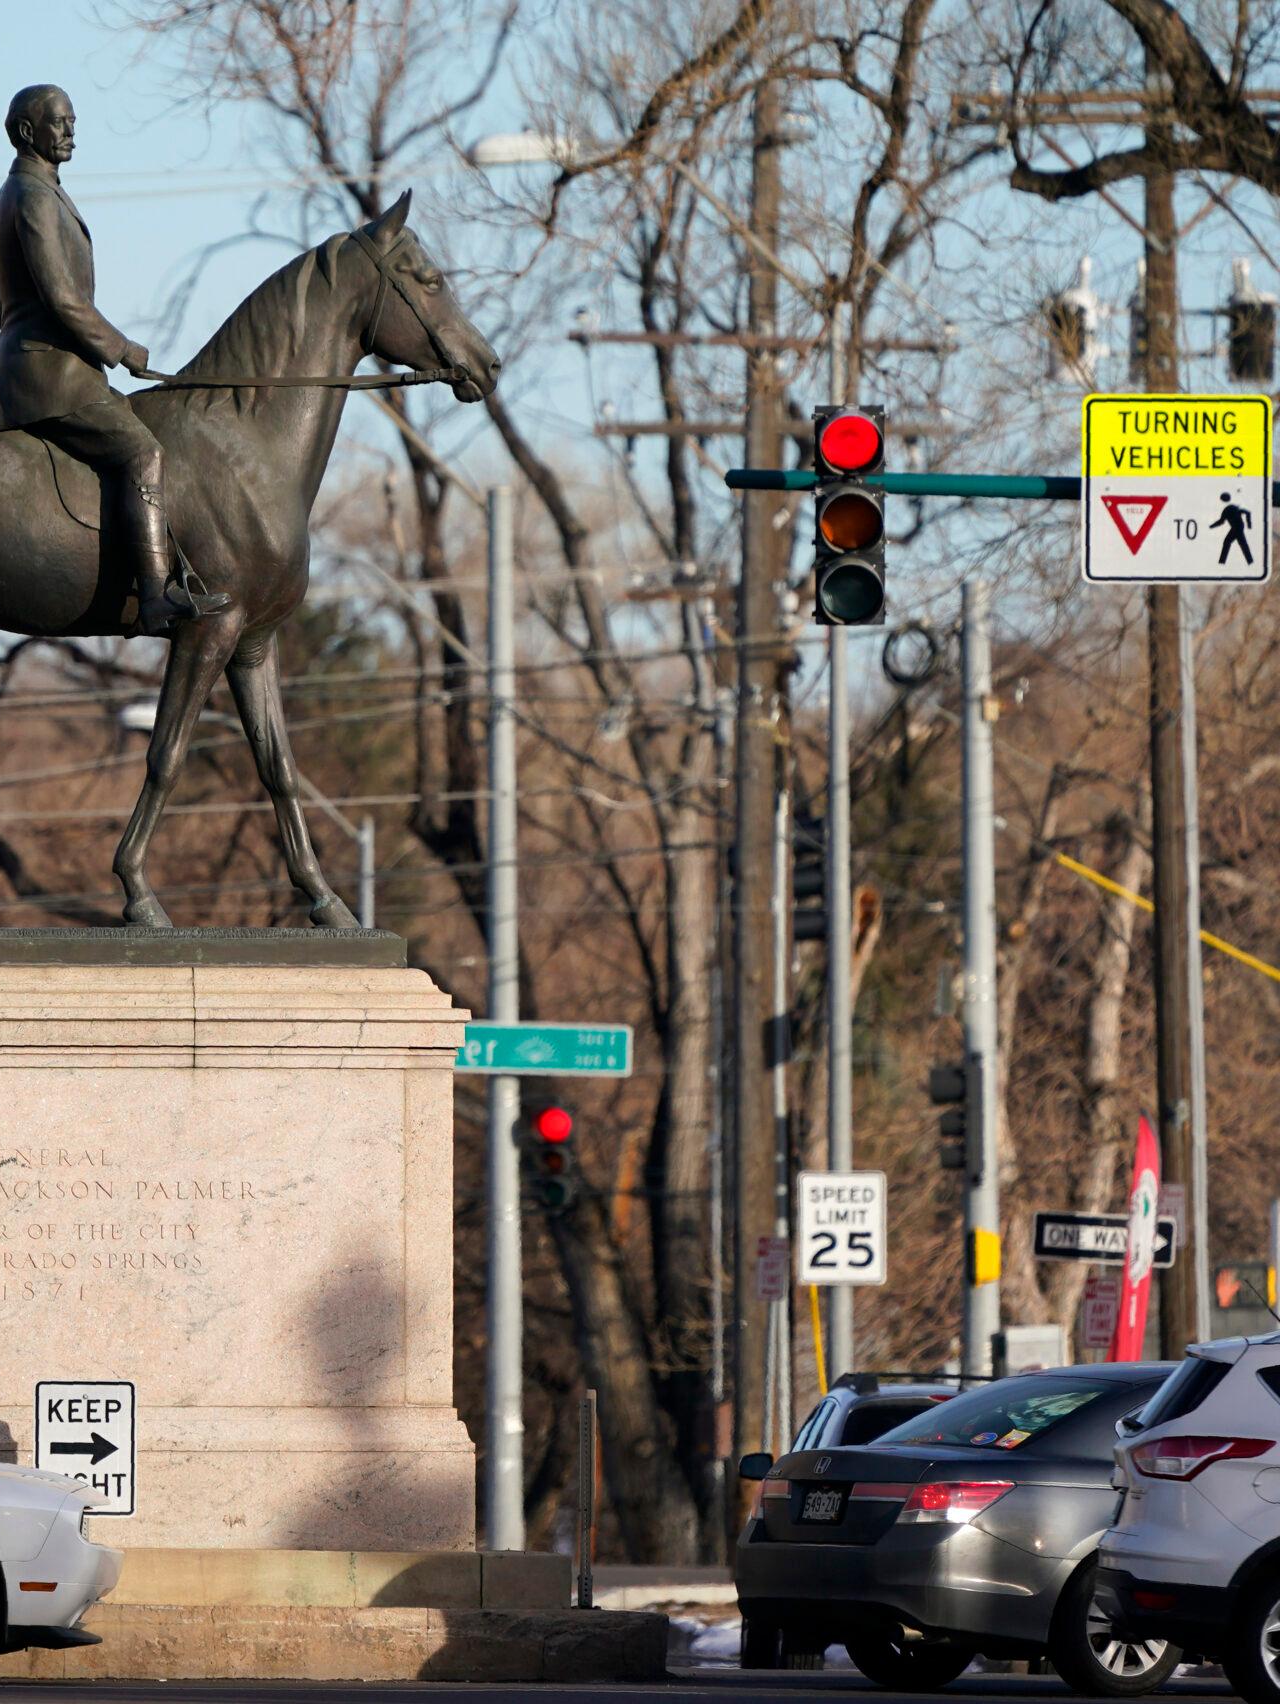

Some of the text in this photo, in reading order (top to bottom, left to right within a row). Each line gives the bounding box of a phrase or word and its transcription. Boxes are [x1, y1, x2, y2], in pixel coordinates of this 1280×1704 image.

[1118, 411, 1238, 434] TURNING
[1110, 446, 1245, 470] VEHICLES
[1174, 519, 1198, 540] TO
[457, 1039, 498, 1066] er
[135, 1180, 257, 1200] PALMER
[810, 1185, 875, 1204] SPEED
[815, 1209, 868, 1225] LIMIT
[27, 1223, 58, 1240] OF
[74, 1223, 122, 1240] THE
[139, 1223, 201, 1240] CITY
[810, 1231, 874, 1268] 25
[91, 1251, 203, 1270] SPRINGS
[2, 1279, 85, 1301] 1871
[48, 1398, 121, 1423] KEEP
